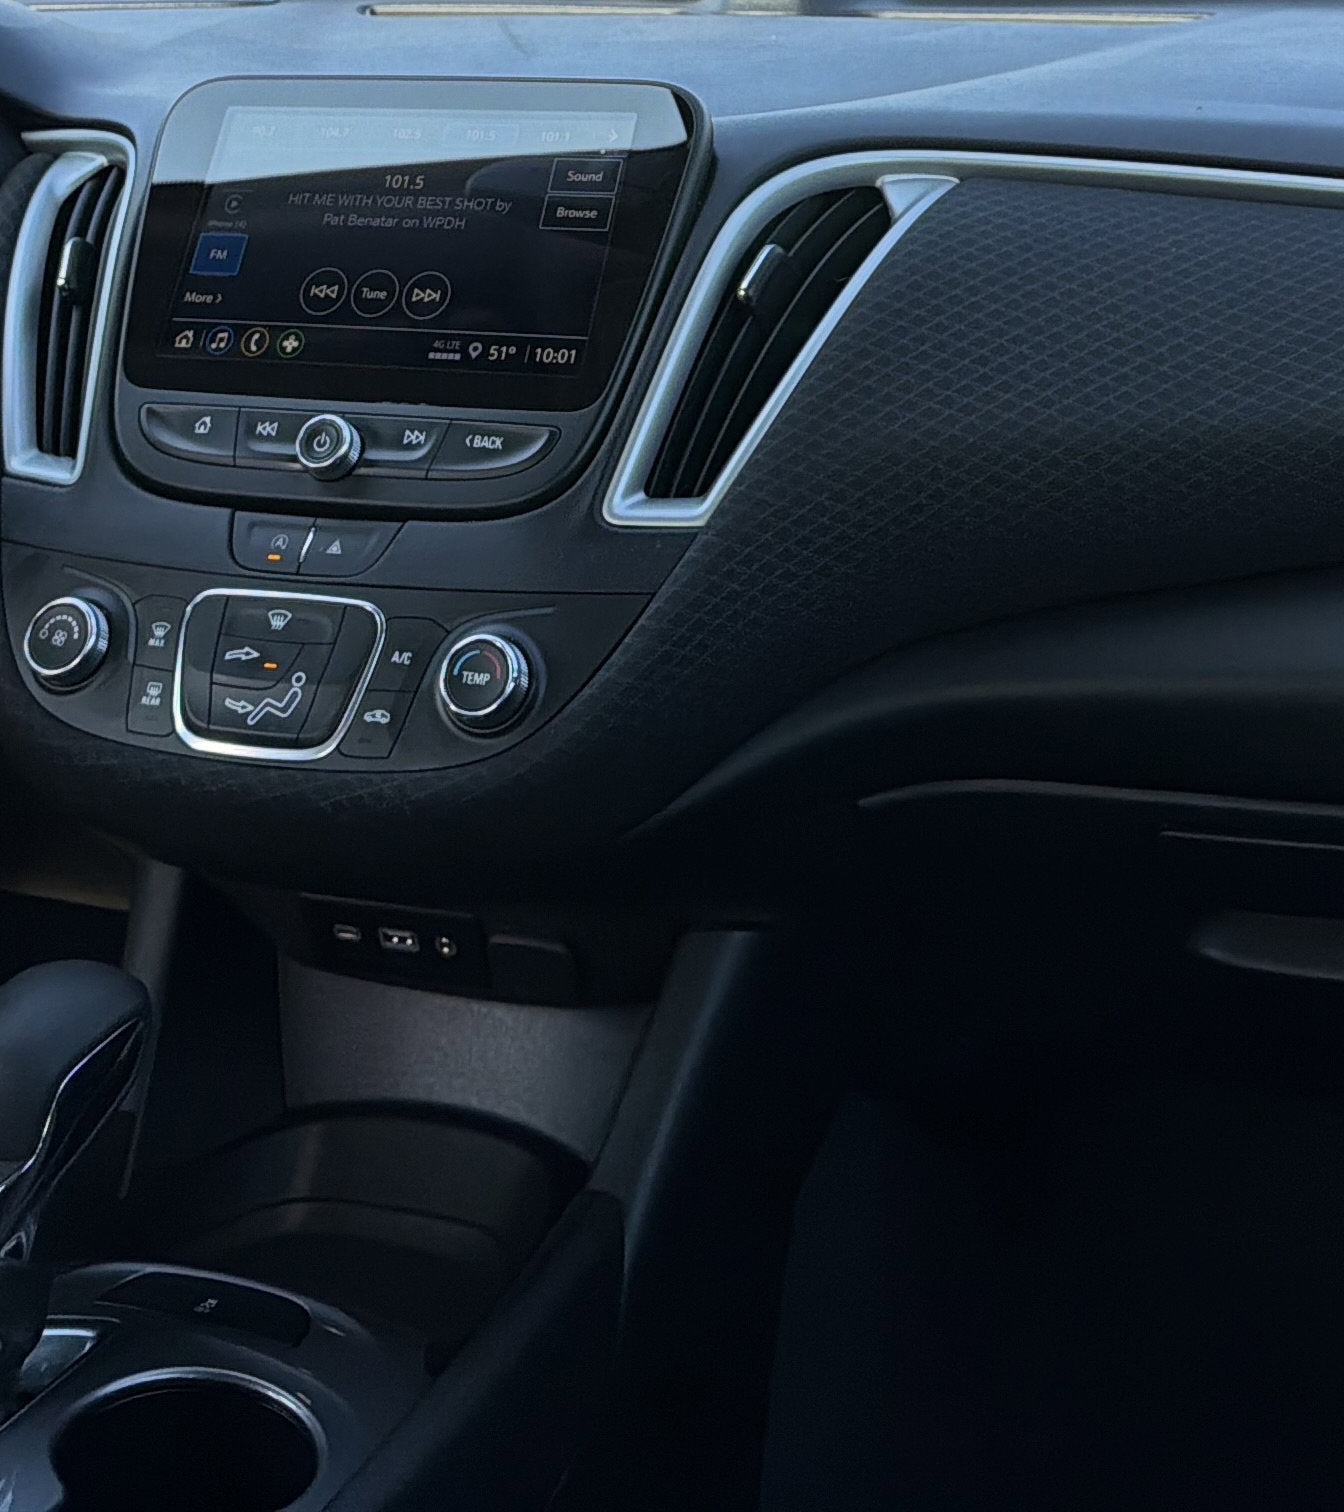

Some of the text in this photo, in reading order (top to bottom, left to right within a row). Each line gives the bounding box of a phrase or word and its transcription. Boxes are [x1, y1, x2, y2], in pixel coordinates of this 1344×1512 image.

[385, 174, 425, 190] 101.5
[566, 170, 604, 183] Sound
[288, 192, 513, 215] HIT ME WITH YOUR BEST SHOT by
[556, 207, 598, 219] Browse
[322, 213, 466, 230] Pat Benatar on WPDH
[208, 249, 228, 260] FM
[184, 291, 213, 303] More
[361, 288, 388, 299] Tune
[433, 340, 462, 350] 4G LTE
[488, 345, 517, 361] 51°
[535, 347, 577, 364] 10:01
[473, 435, 505, 450] BACK
[147, 637, 165, 648] MAX
[390, 650, 413, 665] A/C
[461, 671, 491, 686] TEMP
